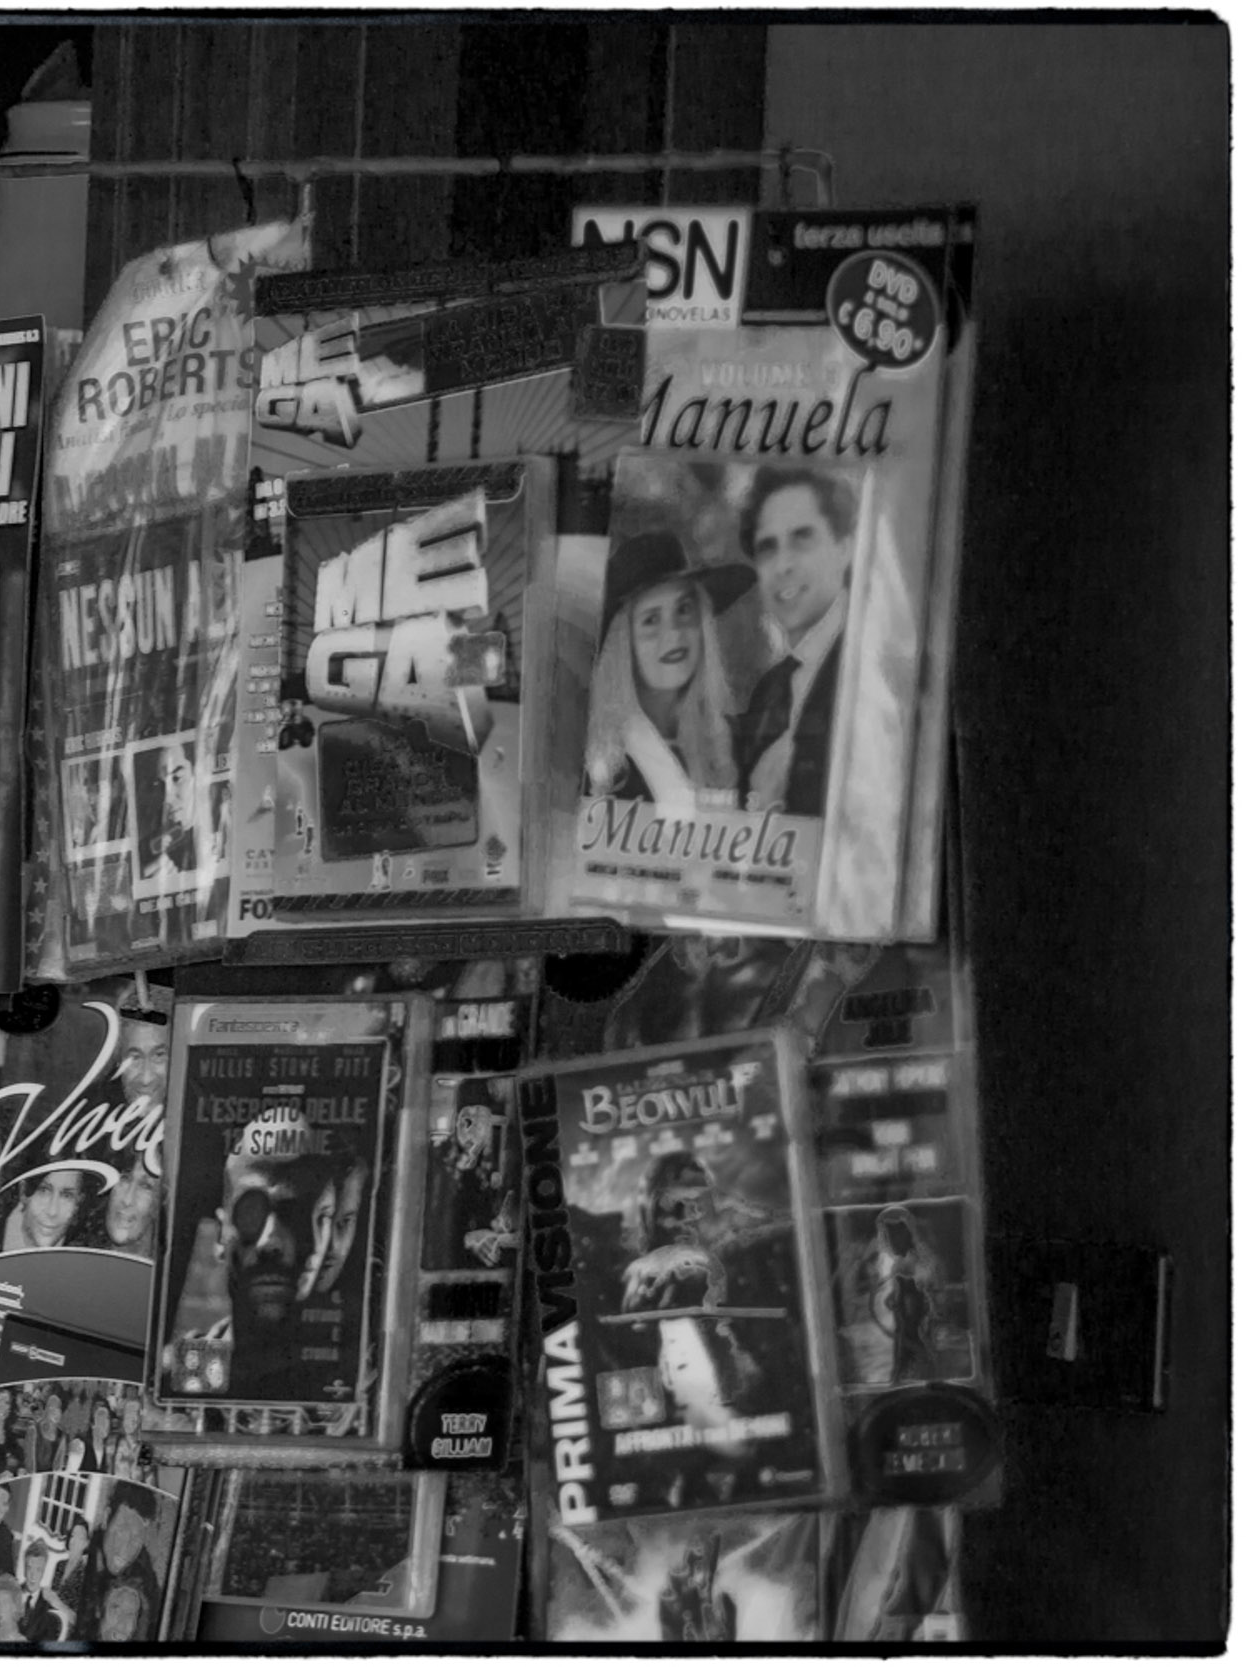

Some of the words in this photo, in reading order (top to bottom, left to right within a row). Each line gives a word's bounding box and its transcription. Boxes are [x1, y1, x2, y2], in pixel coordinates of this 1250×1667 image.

[867, 259, 919, 304] DVD
[123, 307, 212, 367] ERIC
[77, 349, 260, 424] ROBERTS
[313, 486, 490, 634] ME
[58, 564, 177, 671] NESSUN
[305, 610, 491, 724] GA
[581, 795, 797, 868] Manuela
[199, 1056, 254, 1079] WILLIS
[333, 1056, 371, 1079] PITT
[195, 1095, 301, 1125] L'ESERCITO
[304, 1096, 369, 1125] DELLE
[250, 1127, 334, 1157] SCIMMIE
[440, 1412, 488, 1435] TERRY
[430, 1436, 493, 1460] GILLIAM
[287, 1610, 329, 1630] CONTI
[329, 1612, 392, 1636] EDITORE
